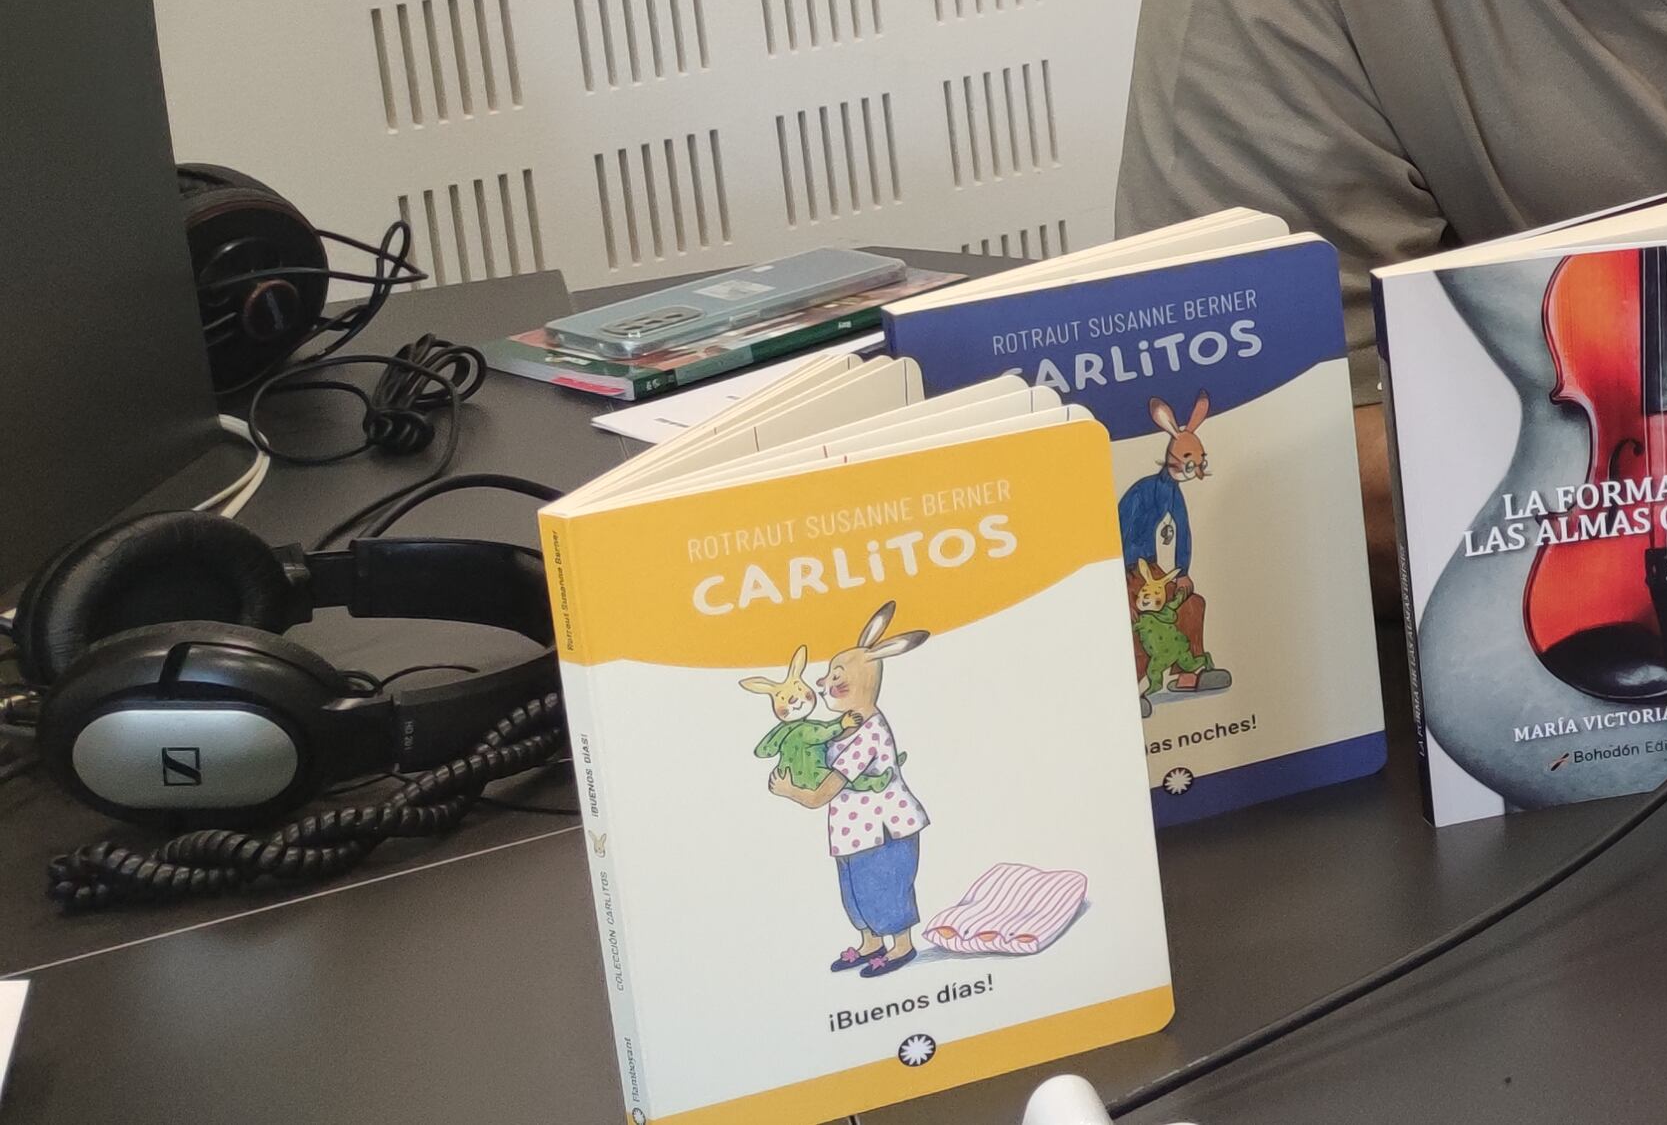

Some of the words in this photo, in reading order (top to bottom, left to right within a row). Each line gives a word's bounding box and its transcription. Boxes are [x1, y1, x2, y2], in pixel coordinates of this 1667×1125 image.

[992, 321, 1081, 356] ROTRAUT
[1089, 303, 1177, 338] SUSANNE
[1184, 289, 1258, 321] BERNER
[687, 520, 797, 563] ROTRAUT
[807, 497, 913, 539] SUSANNE
[922, 479, 1012, 517] BERNER
[1503, 490, 1549, 520] LA
[1464, 523, 1526, 557] LAS
[1535, 507, 1651, 546] ALMAS
[1178, 713, 1257, 748] noches!
[1513, 716, 1579, 742] MARÍA
[1574, 745, 1640, 764] Bohodón
[829, 994, 930, 1033] ¡Buenos
[936, 973, 994, 1004] días!
